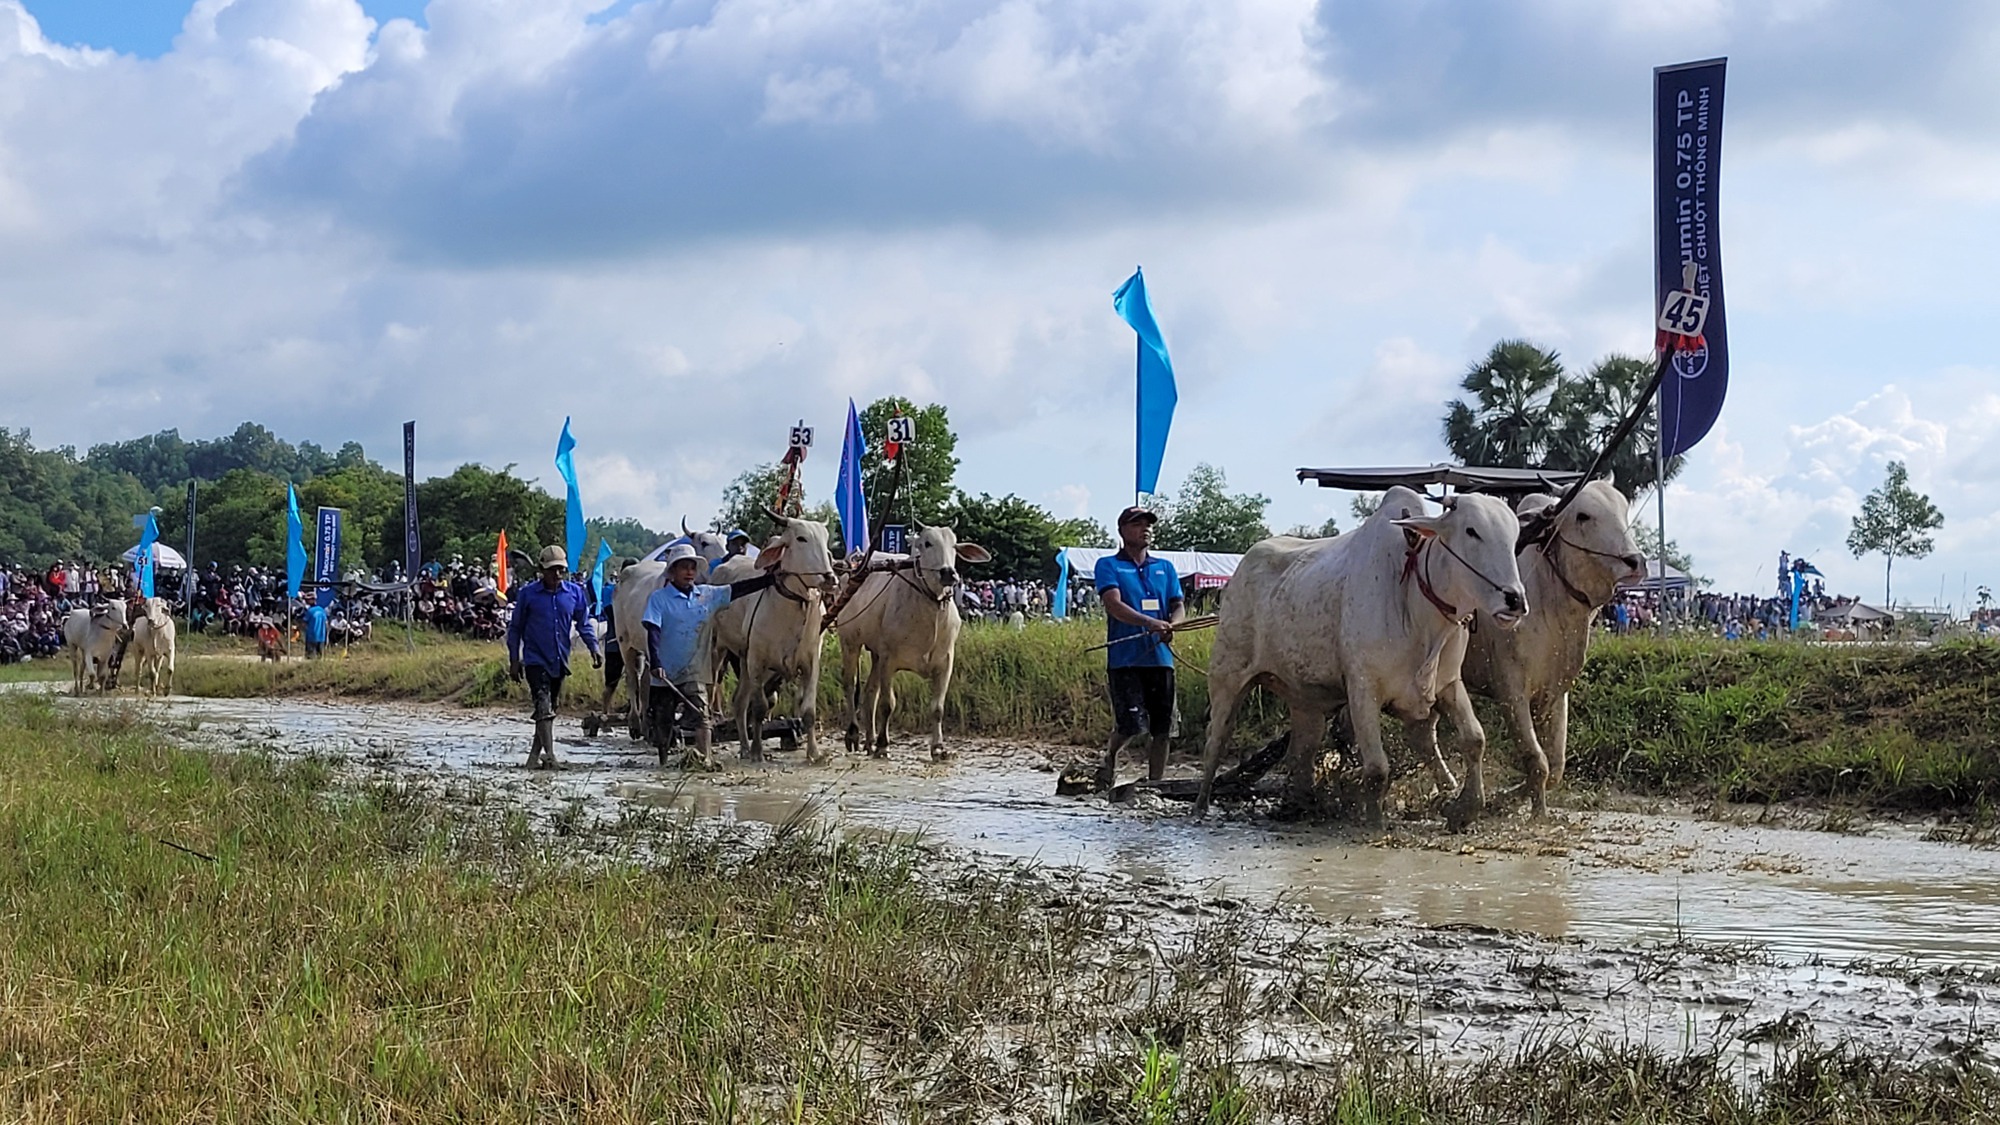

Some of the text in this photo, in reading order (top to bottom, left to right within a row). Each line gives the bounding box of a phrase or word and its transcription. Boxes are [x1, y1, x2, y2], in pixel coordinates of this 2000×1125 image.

[1677, 89, 1694, 128] TP
[1697, 86, 1710, 131] MINH
[1676, 133, 1692, 189] 0.75
[1693, 135, 1708, 195] THÔNG
[1693, 199, 1708, 259] CHUỘT
[1665, 295, 1704, 332] 45
[791, 427, 811, 446] 53
[889, 418, 912, 442] 31
[324, 514, 331, 525] TP
[138, 556, 148, 565] 51
